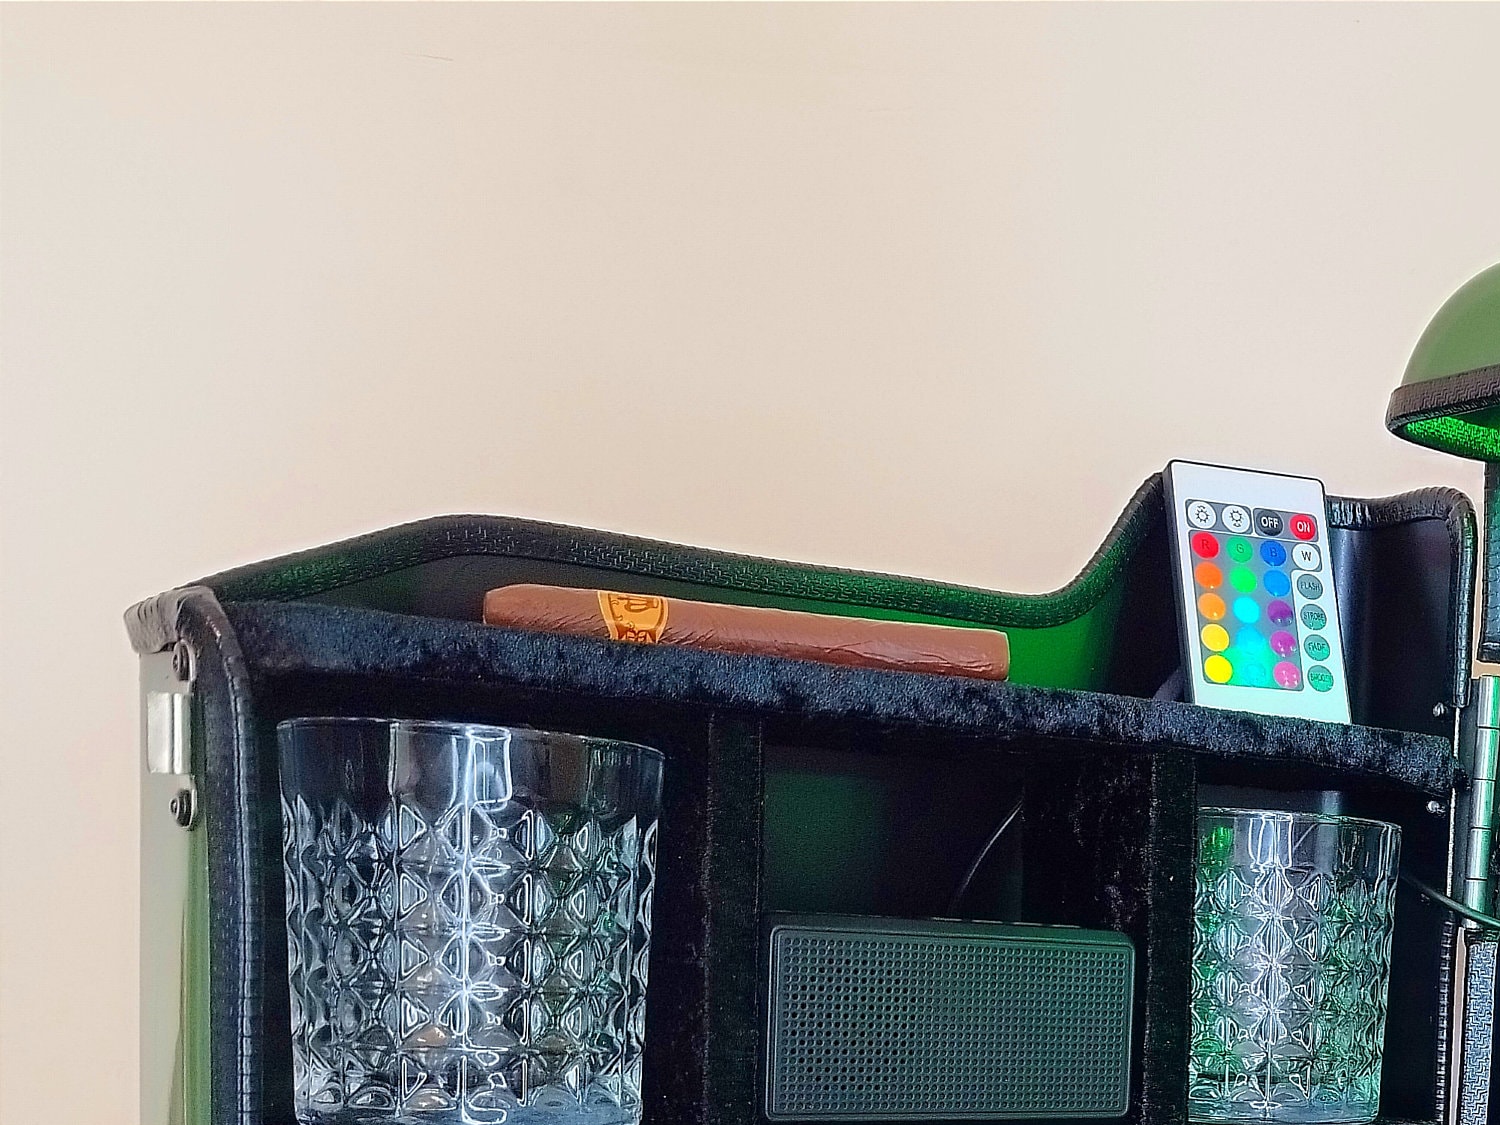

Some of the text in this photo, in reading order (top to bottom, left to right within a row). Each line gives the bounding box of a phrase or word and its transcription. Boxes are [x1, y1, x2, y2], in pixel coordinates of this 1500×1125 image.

[1261, 516, 1311, 533] OFF ON
[1202, 539, 1210, 550] R
[1301, 551, 1312, 562] W
